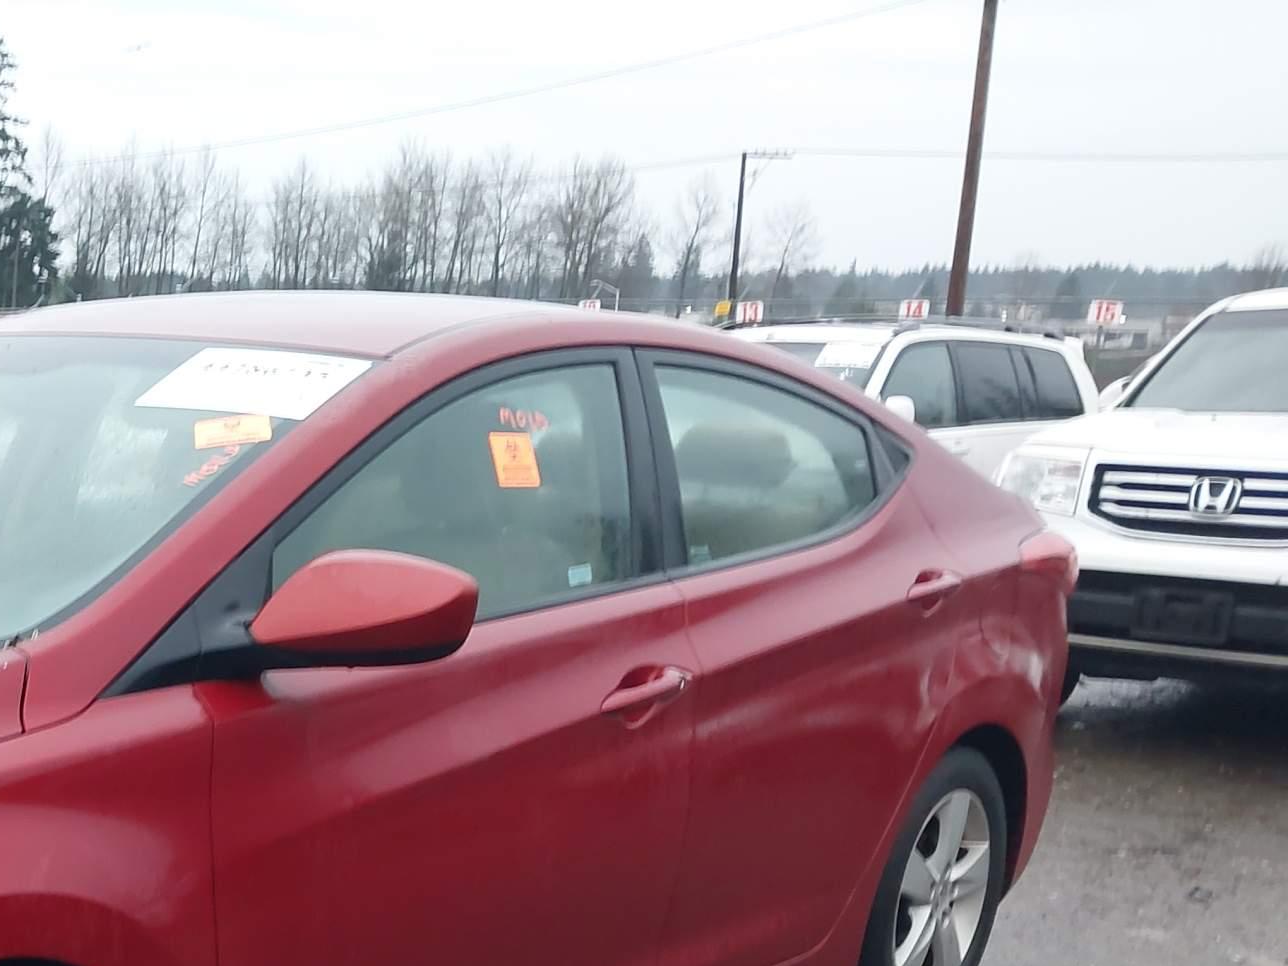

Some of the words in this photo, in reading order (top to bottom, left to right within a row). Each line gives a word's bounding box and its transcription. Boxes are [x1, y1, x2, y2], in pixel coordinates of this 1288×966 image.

[743, 302, 759, 323] 13
[906, 301, 924, 319] 14
[1096, 301, 1118, 322] 15
